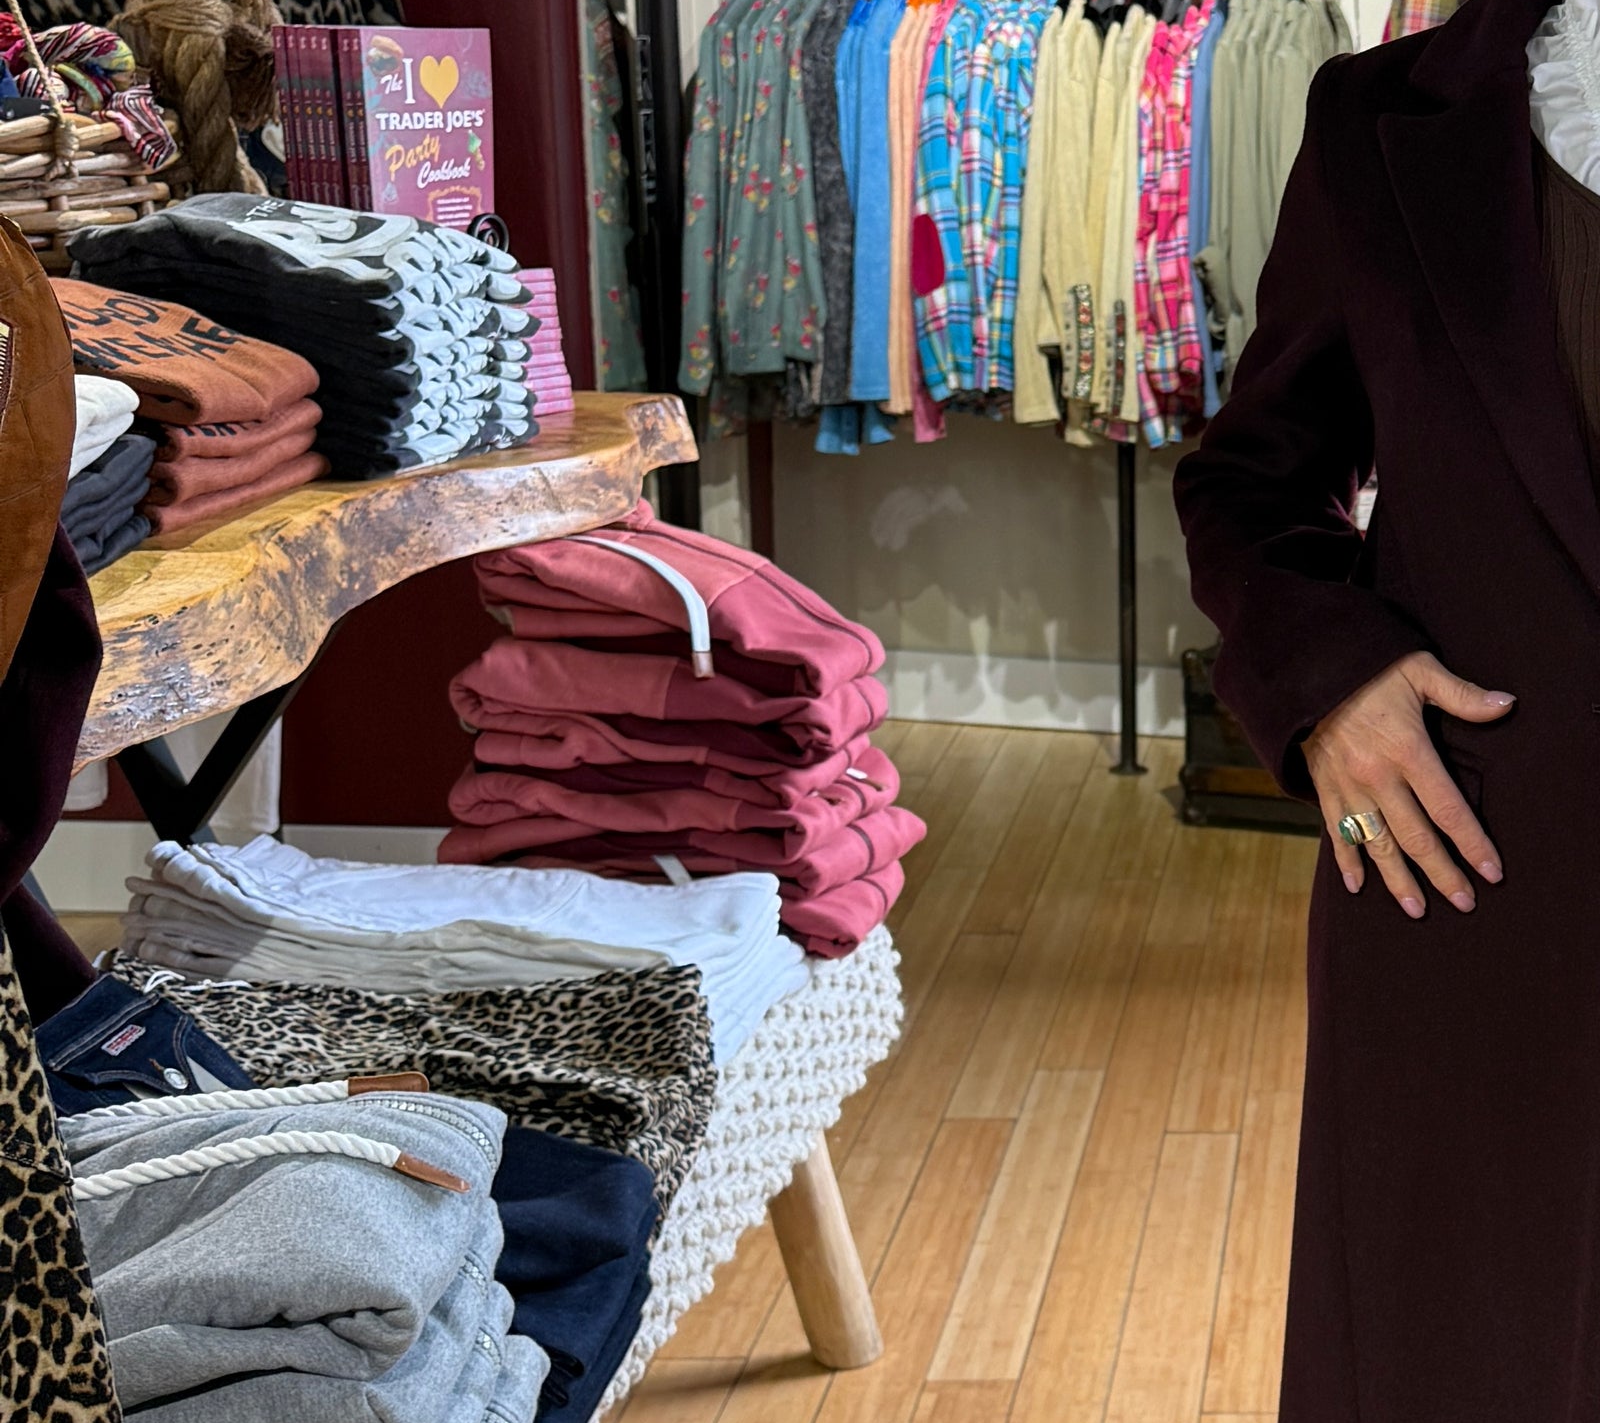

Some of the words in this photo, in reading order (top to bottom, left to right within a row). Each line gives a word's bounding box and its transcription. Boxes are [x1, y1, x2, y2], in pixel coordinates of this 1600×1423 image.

[381, 74, 403, 94] The
[403, 58, 416, 104] I
[375, 112, 444, 131] TRADER
[445, 111, 484, 133] JOE'S
[385, 133, 440, 181] Party
[417, 158, 472, 189] Cookbook
